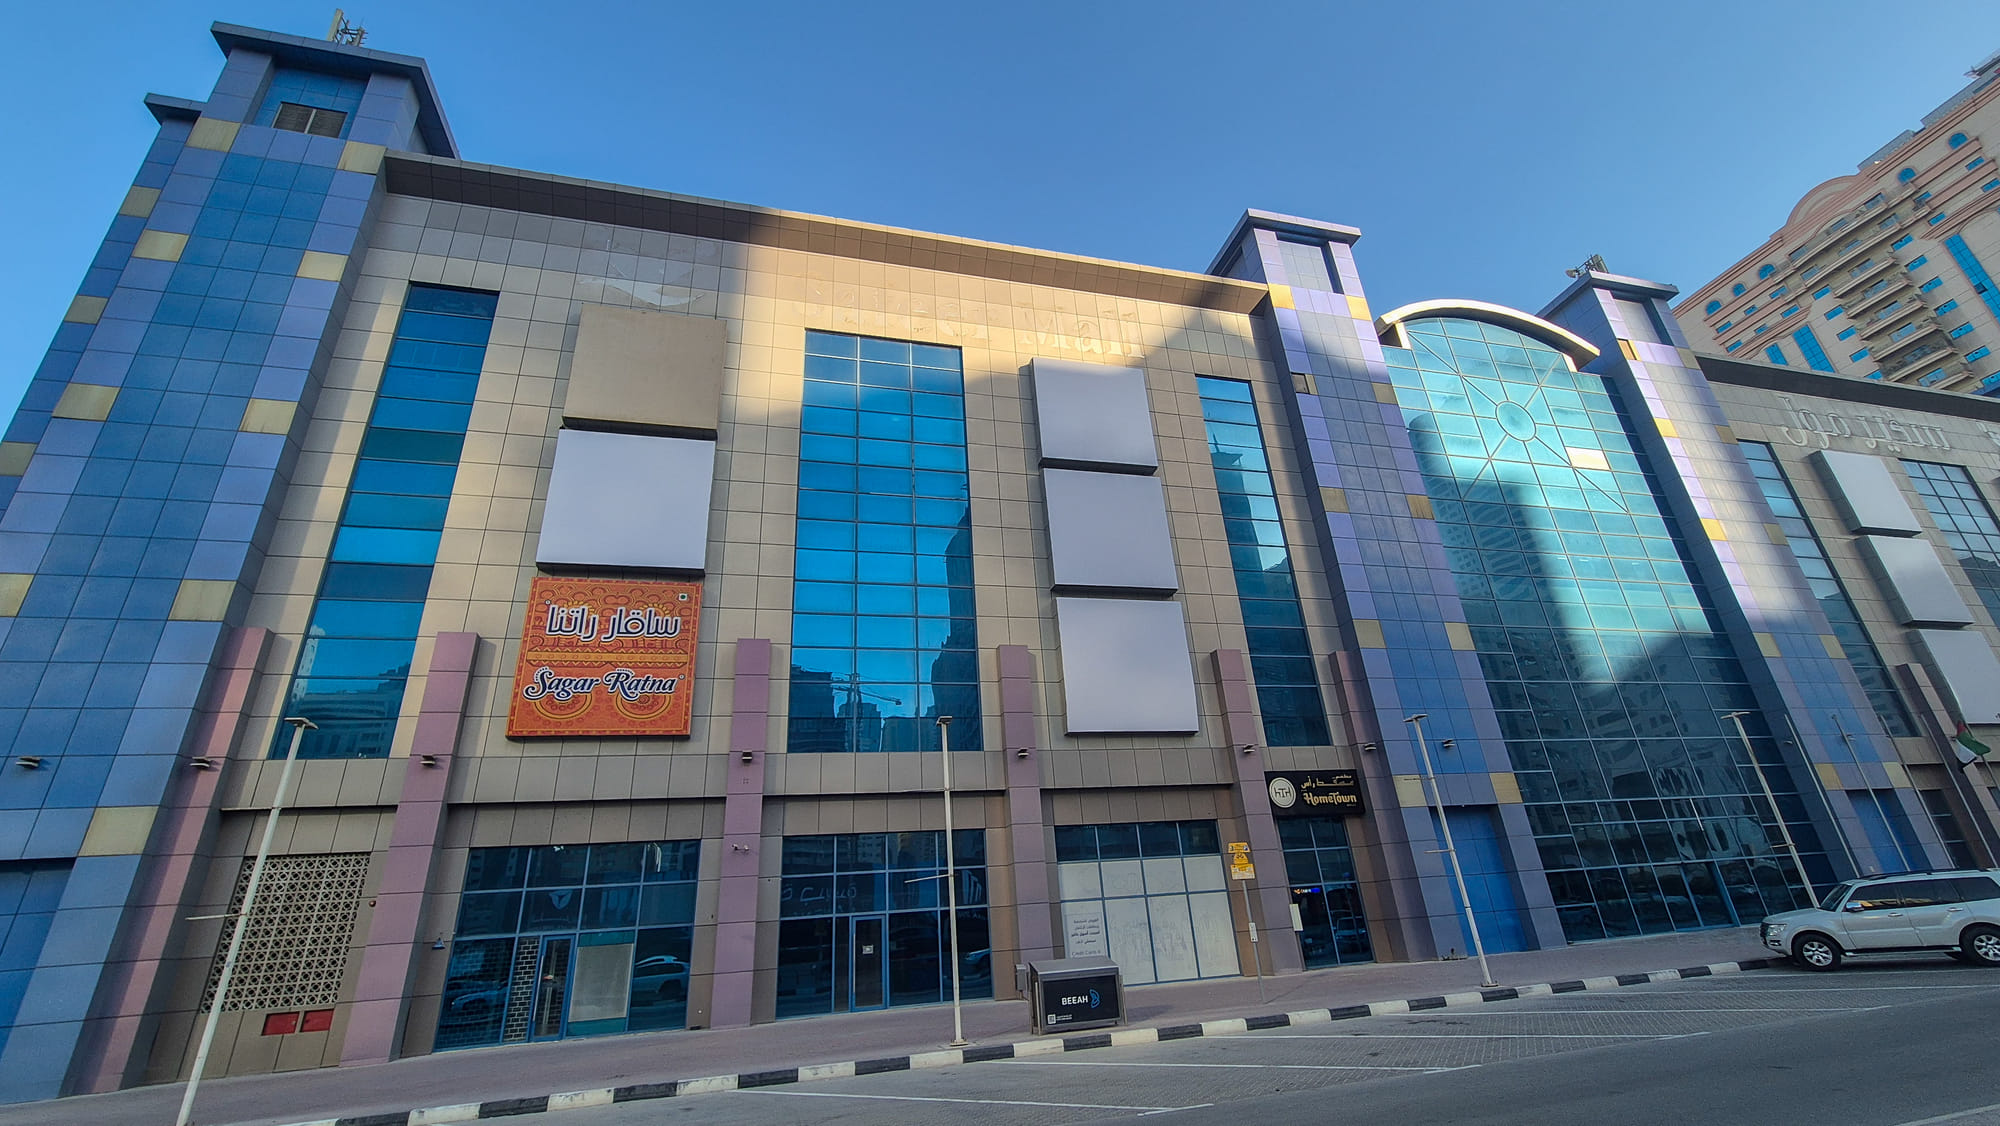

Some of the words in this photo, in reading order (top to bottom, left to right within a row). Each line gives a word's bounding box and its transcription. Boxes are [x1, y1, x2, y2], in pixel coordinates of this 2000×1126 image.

[1778, 396, 1851, 449] مول
[1856, 411, 1951, 452] سفير
[546, 605, 598, 642] راتنا
[523, 667, 600, 701] Sagar
[603, 668, 679, 701] Ratna
[1303, 792, 1357, 806] HomeTown
[1061, 995, 1088, 1005] BEEAH
